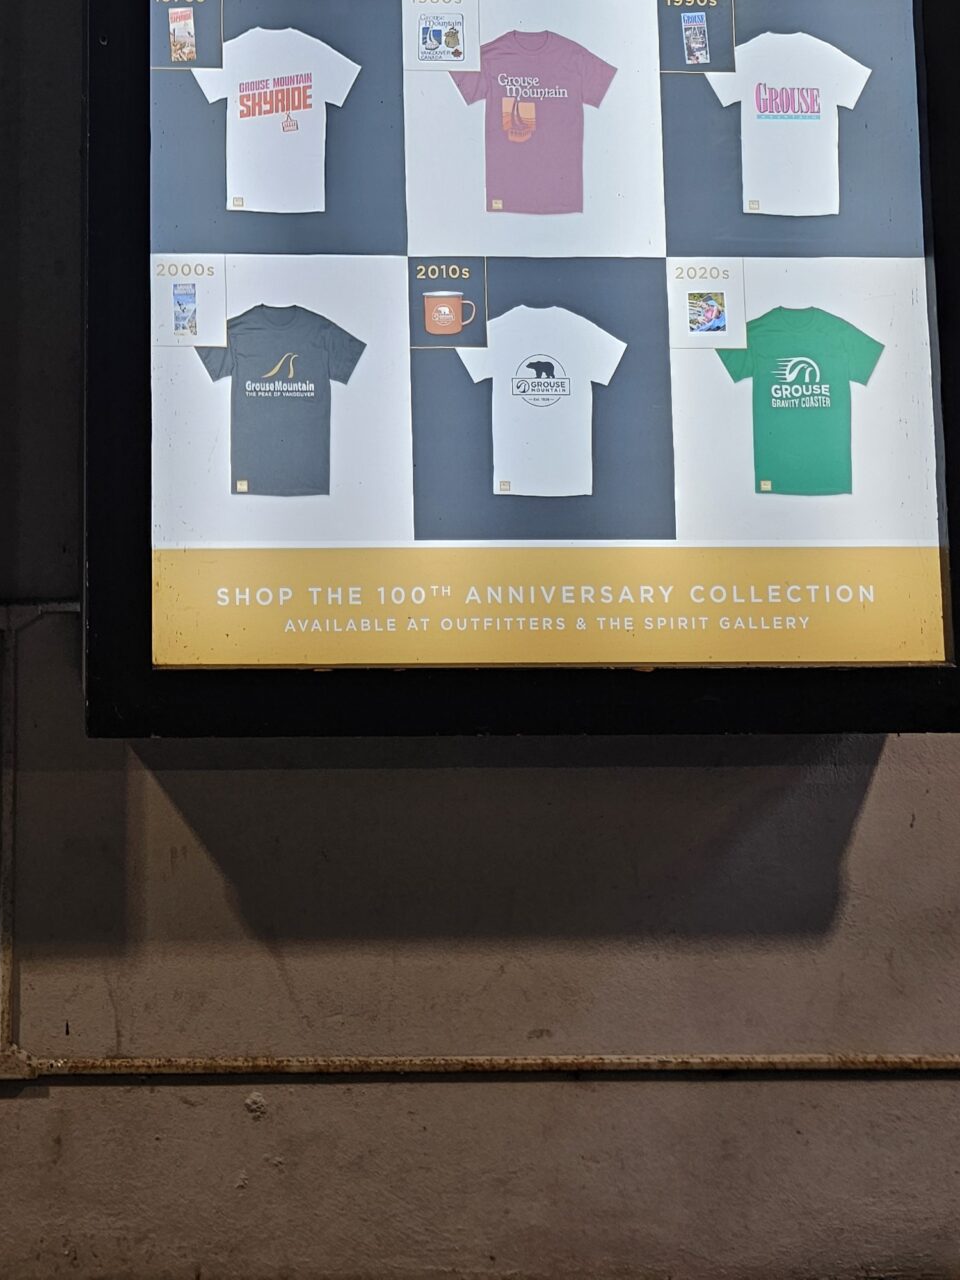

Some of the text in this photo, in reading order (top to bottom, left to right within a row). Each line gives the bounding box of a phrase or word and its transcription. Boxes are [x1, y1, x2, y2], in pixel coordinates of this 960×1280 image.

[239, 72, 312, 93] GROUSE MOUNTAIN
[497, 73, 540, 89] Grouse
[239, 85, 313, 118] SKYRIDE
[156, 263, 215, 277] 2000s
[416, 265, 470, 279] 2010s
[675, 266, 730, 280] 2020s
[771, 384, 830, 398] GROUSE
[771, 396, 831, 408] GRAVITY COASTER
[216, 586, 293, 606] SHOP
[308, 586, 362, 605] THE
[465, 585, 674, 605] ANNIVERSARY
[689, 584, 874, 604] COLLECTION
[284, 616, 810, 632] AVAILABLE AT OUTFITTERS & THE SPIRIT GALLERY
